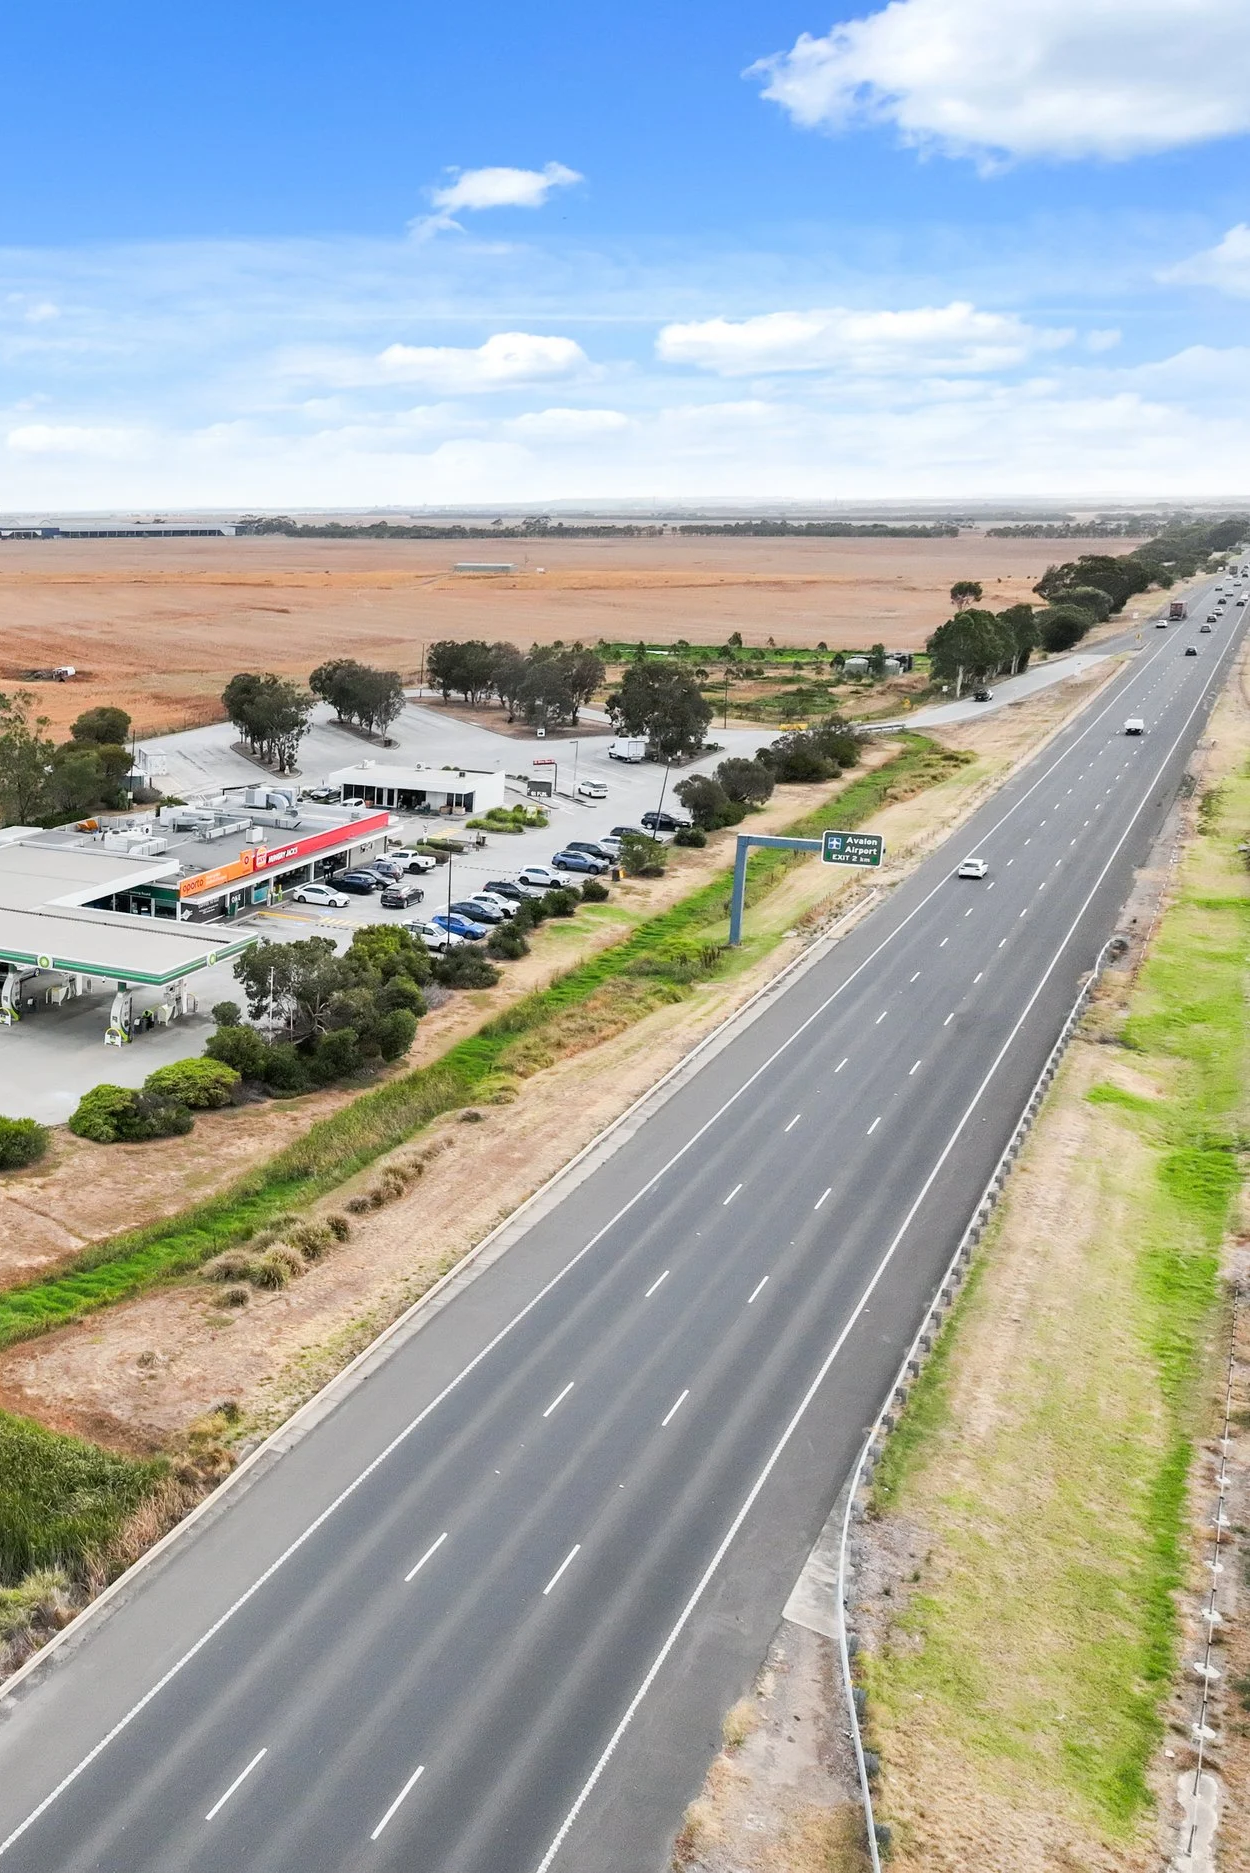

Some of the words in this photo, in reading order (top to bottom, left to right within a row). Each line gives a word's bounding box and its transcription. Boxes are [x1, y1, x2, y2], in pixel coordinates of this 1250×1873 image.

[846, 836, 878, 845] Avalon
[845, 846, 878, 855] Airport
[182, 879, 204, 894] oporto
